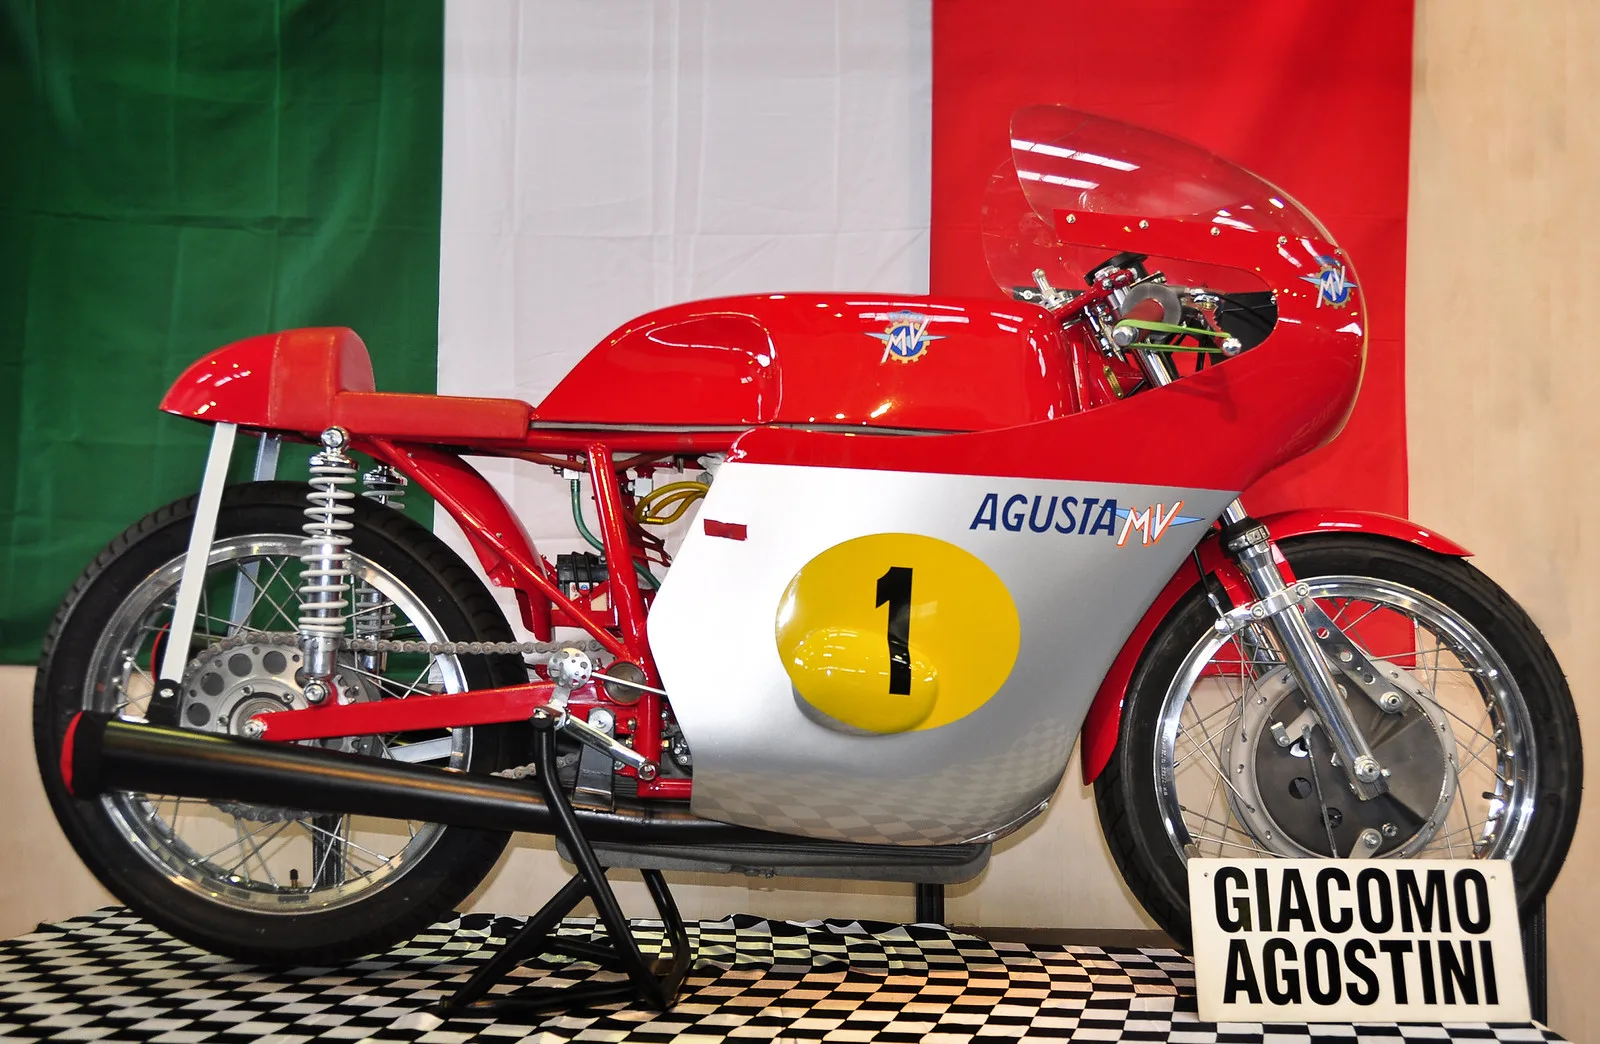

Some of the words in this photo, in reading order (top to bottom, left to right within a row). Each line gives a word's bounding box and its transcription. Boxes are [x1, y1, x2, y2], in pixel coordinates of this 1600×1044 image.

[881, 317, 930, 364] MV
[969, 493, 1117, 536] AGUSTA
[1117, 500, 1184, 548] MV
[875, 566, 913, 696] 1
[1213, 866, 1491, 934] GIACOMO
[1223, 937, 1499, 1006] AGOSTINI
